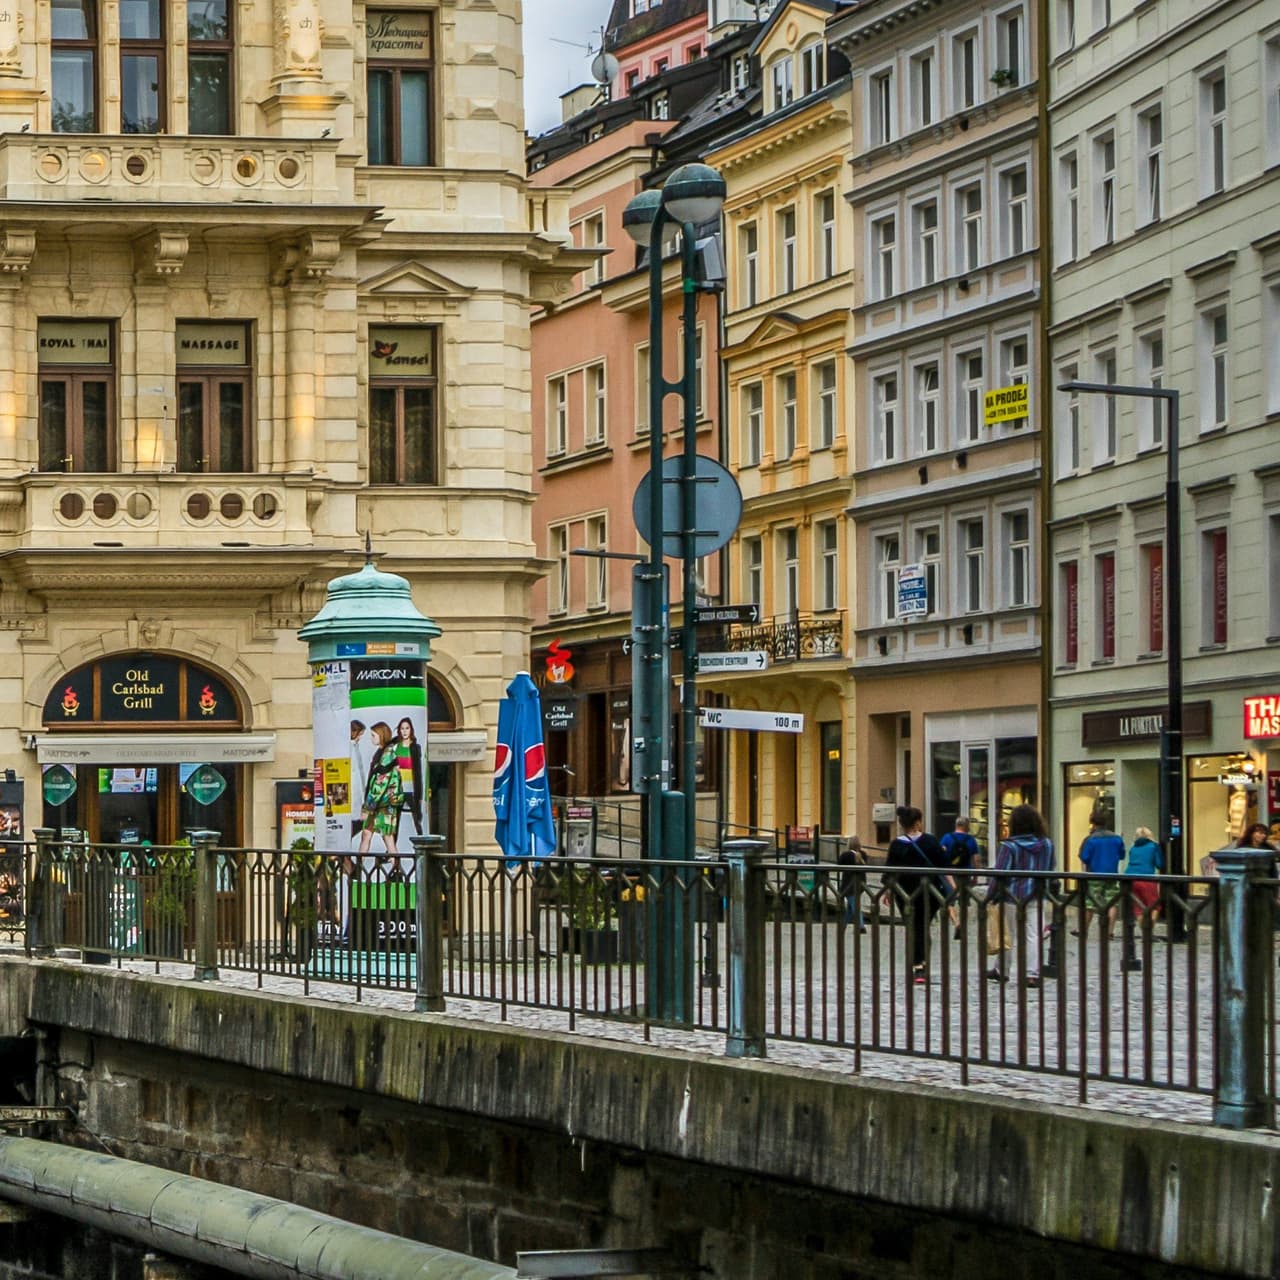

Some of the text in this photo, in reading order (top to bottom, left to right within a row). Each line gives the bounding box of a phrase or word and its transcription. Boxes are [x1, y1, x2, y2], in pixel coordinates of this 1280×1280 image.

[181, 339, 239, 350] MASSAGE
[126, 670, 149, 681] Old
[112, 682, 164, 695] Carlsbad
[124, 697, 152, 709] Grill
[707, 712, 800, 728] WC 100 m
[1120, 715, 1163, 736] LA FORTUN
